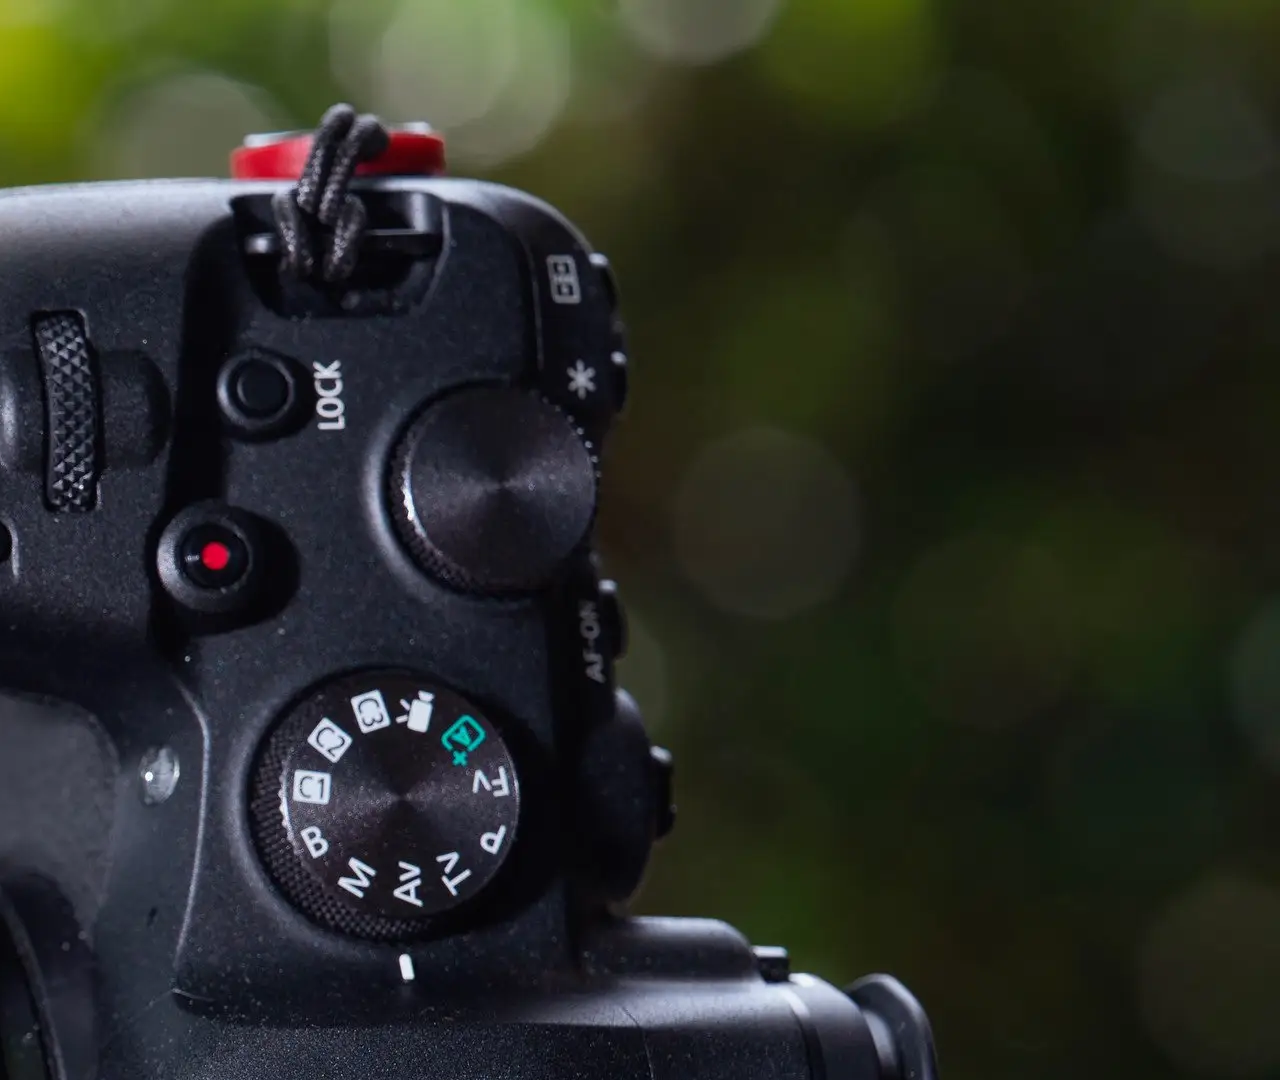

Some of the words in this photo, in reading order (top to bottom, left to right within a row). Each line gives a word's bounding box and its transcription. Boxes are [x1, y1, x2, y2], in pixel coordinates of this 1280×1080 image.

[313, 360, 345, 430] LOCK
[356, 696, 386, 729] C3
[313, 724, 348, 760] C2
[297, 774, 327, 801] C1
[473, 765, 510, 797] Fv
[300, 825, 329, 859] B
[480, 824, 506, 855] P
[337, 856, 377, 898] M
[393, 861, 424, 907] Av
[436, 851, 472, 896] Tv
